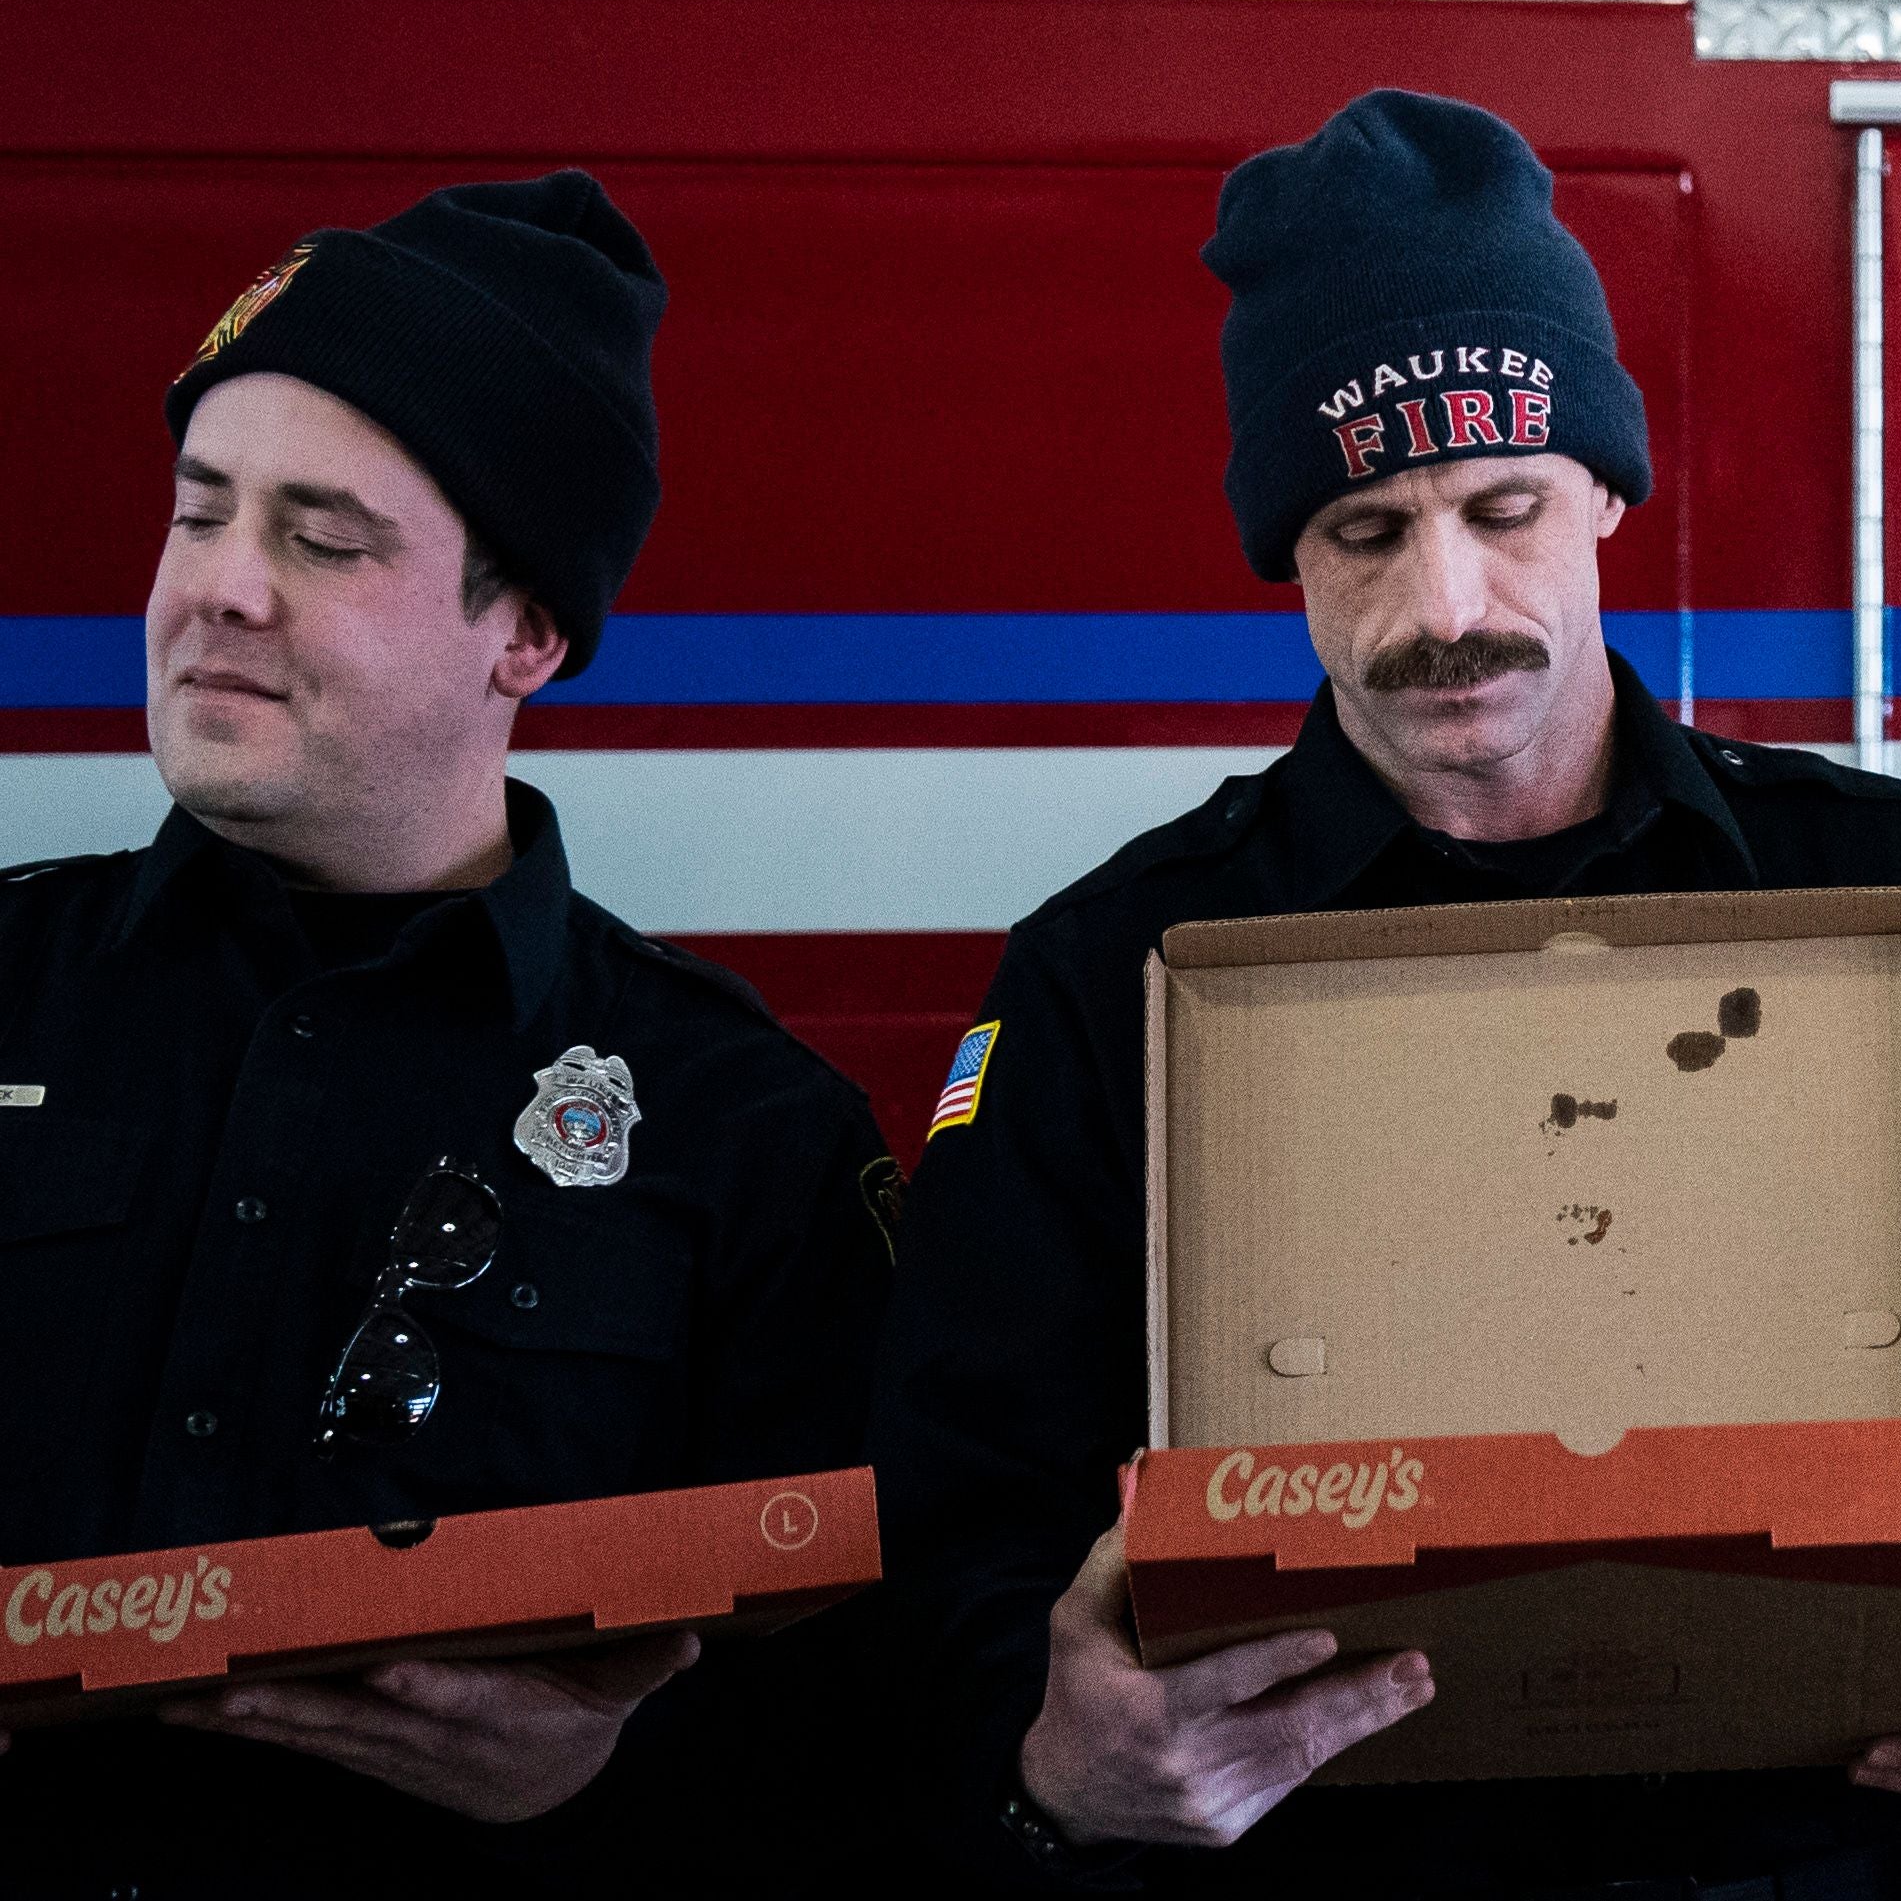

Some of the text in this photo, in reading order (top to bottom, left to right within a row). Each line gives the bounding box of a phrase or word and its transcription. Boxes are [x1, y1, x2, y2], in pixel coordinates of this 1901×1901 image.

[1318, 347, 1554, 423] WAUKEE
[1333, 389, 1552, 478] FIRE
[783, 1510, 798, 1533] L
[1205, 1447, 1425, 1529] Casey's
[5, 1555, 233, 1646] Casey's
